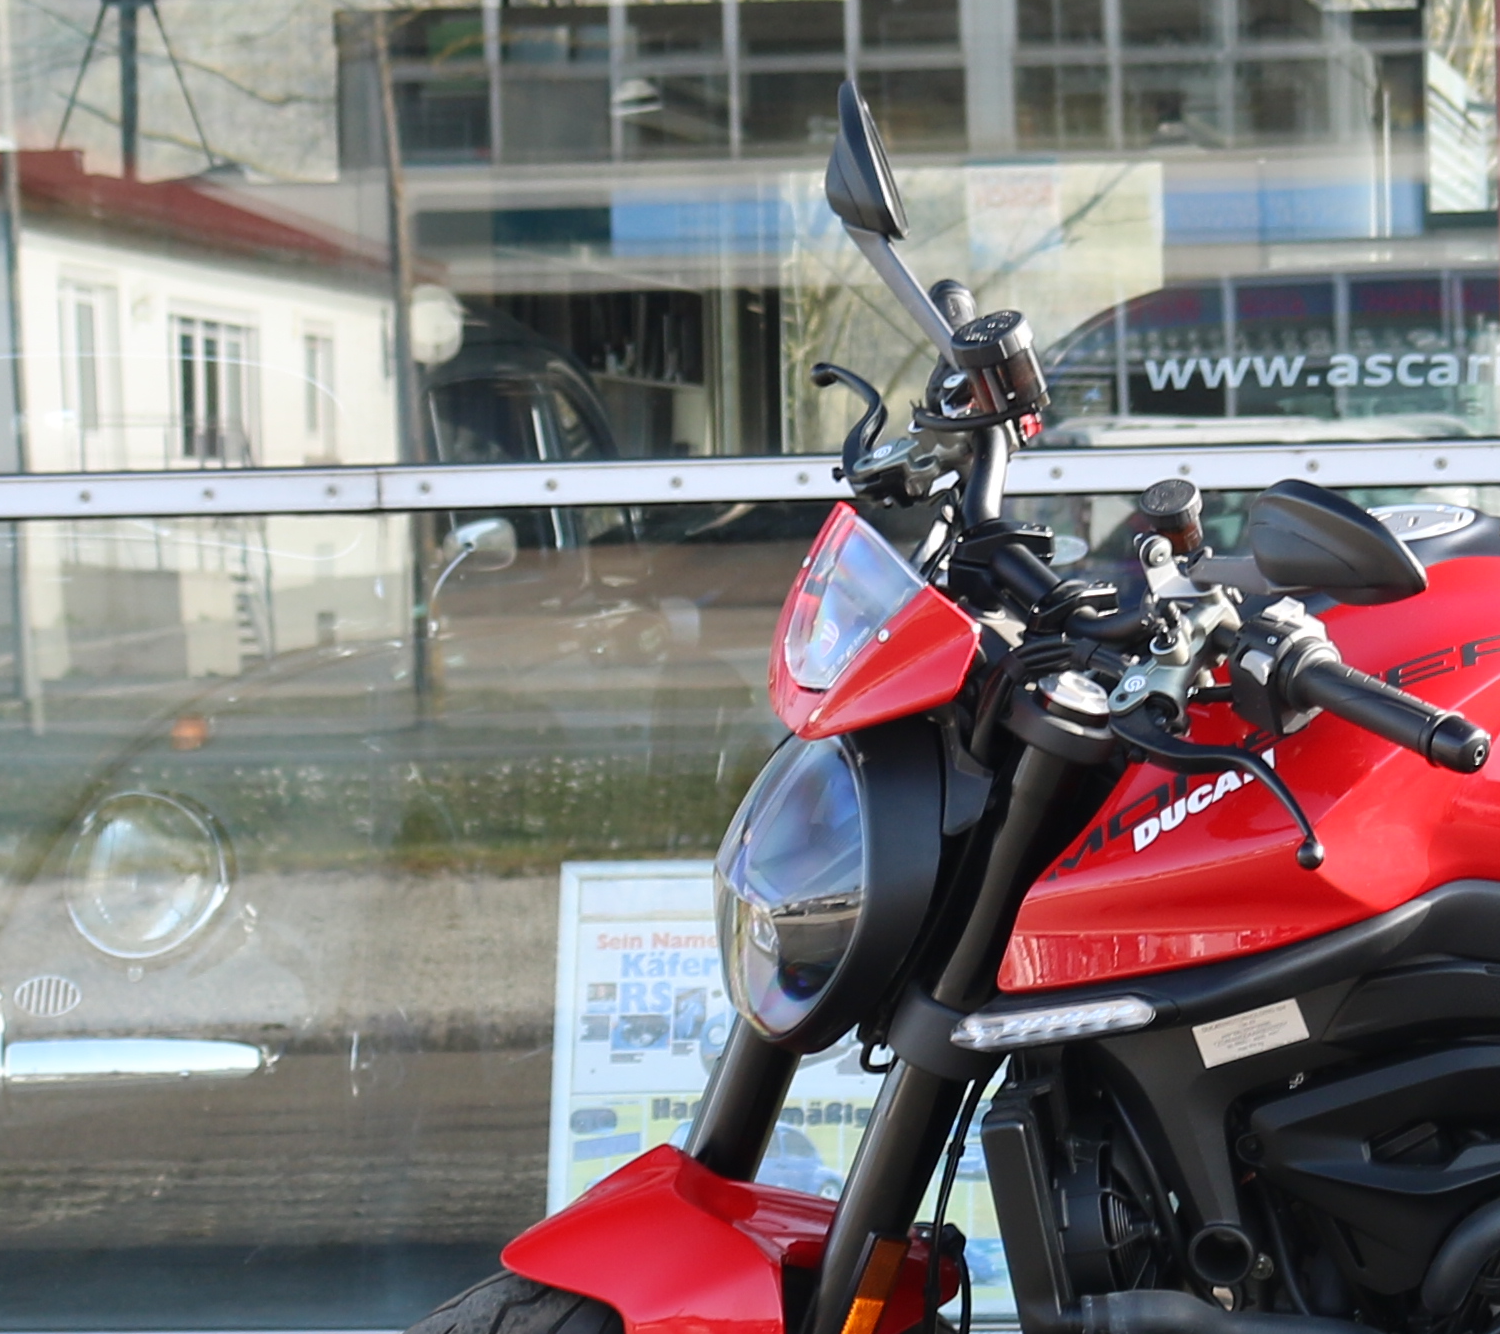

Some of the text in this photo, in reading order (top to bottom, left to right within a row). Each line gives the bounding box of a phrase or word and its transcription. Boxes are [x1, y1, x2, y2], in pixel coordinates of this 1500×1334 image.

[596, 933, 643, 950] Sein
[620, 951, 719, 979] Käfer
[619, 981, 673, 1014] RS
